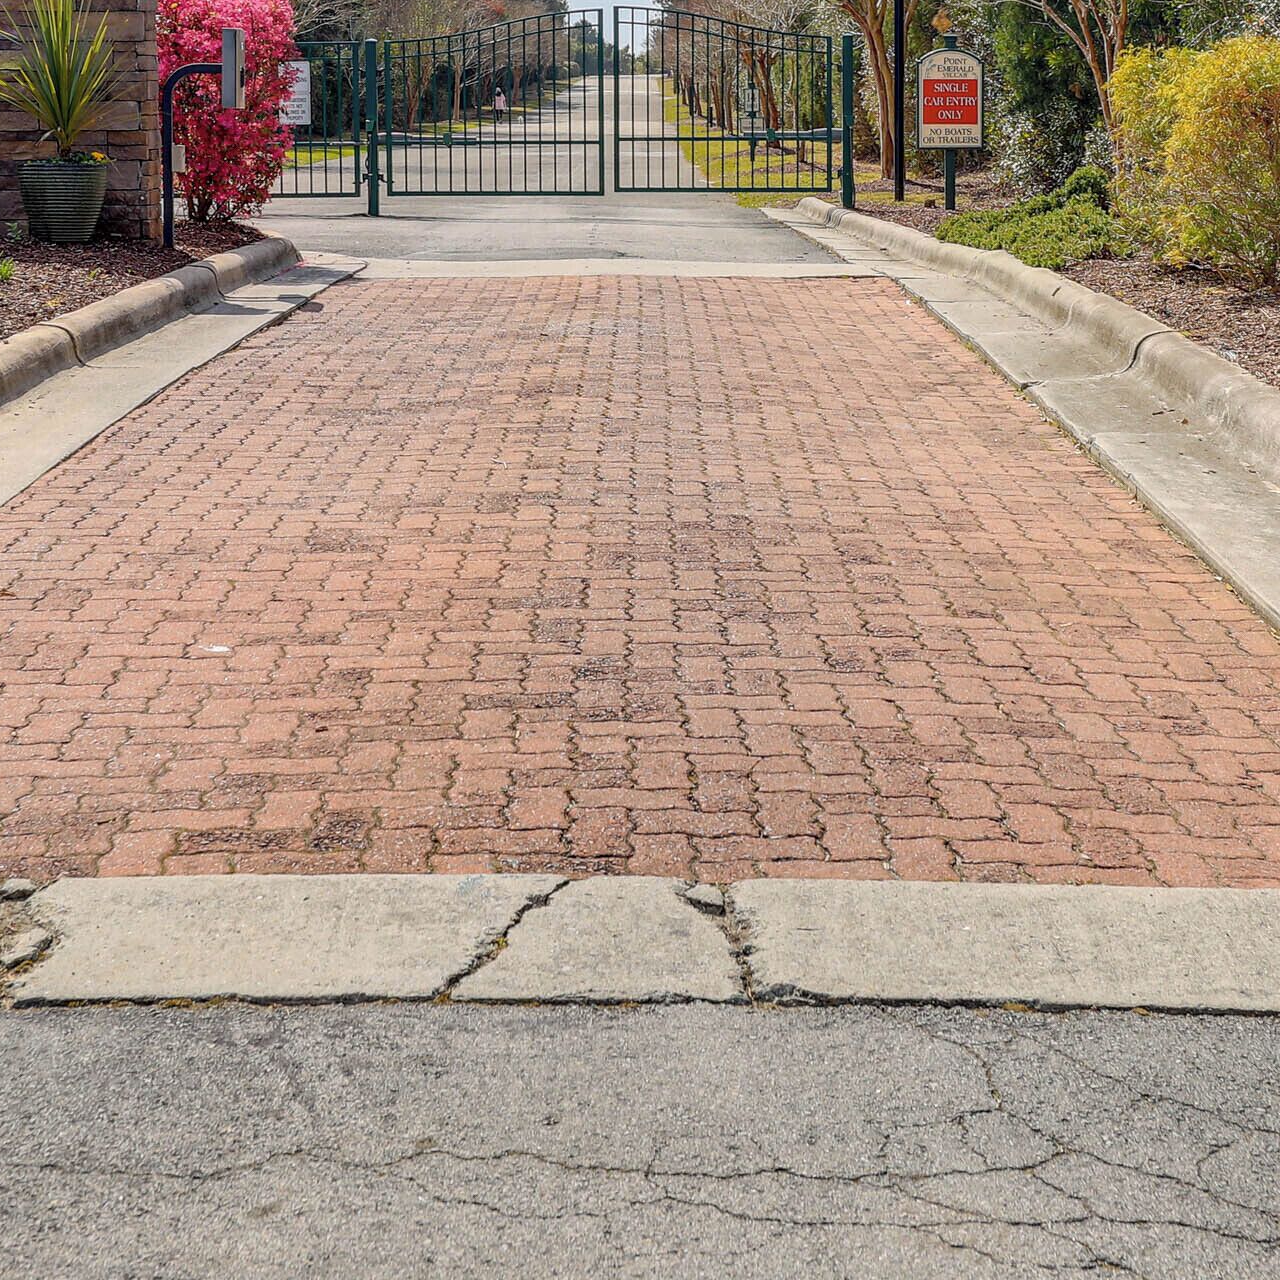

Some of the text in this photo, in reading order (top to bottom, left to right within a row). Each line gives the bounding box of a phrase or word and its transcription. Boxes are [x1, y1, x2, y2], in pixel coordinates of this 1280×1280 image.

[944, 57, 967, 65] POINT
[934, 83, 968, 92] SINGLE
[924, 97, 977, 106] CAR ENTRY
[938, 110, 963, 119] ONLY
[938, 136, 979, 144] TRAILERS
